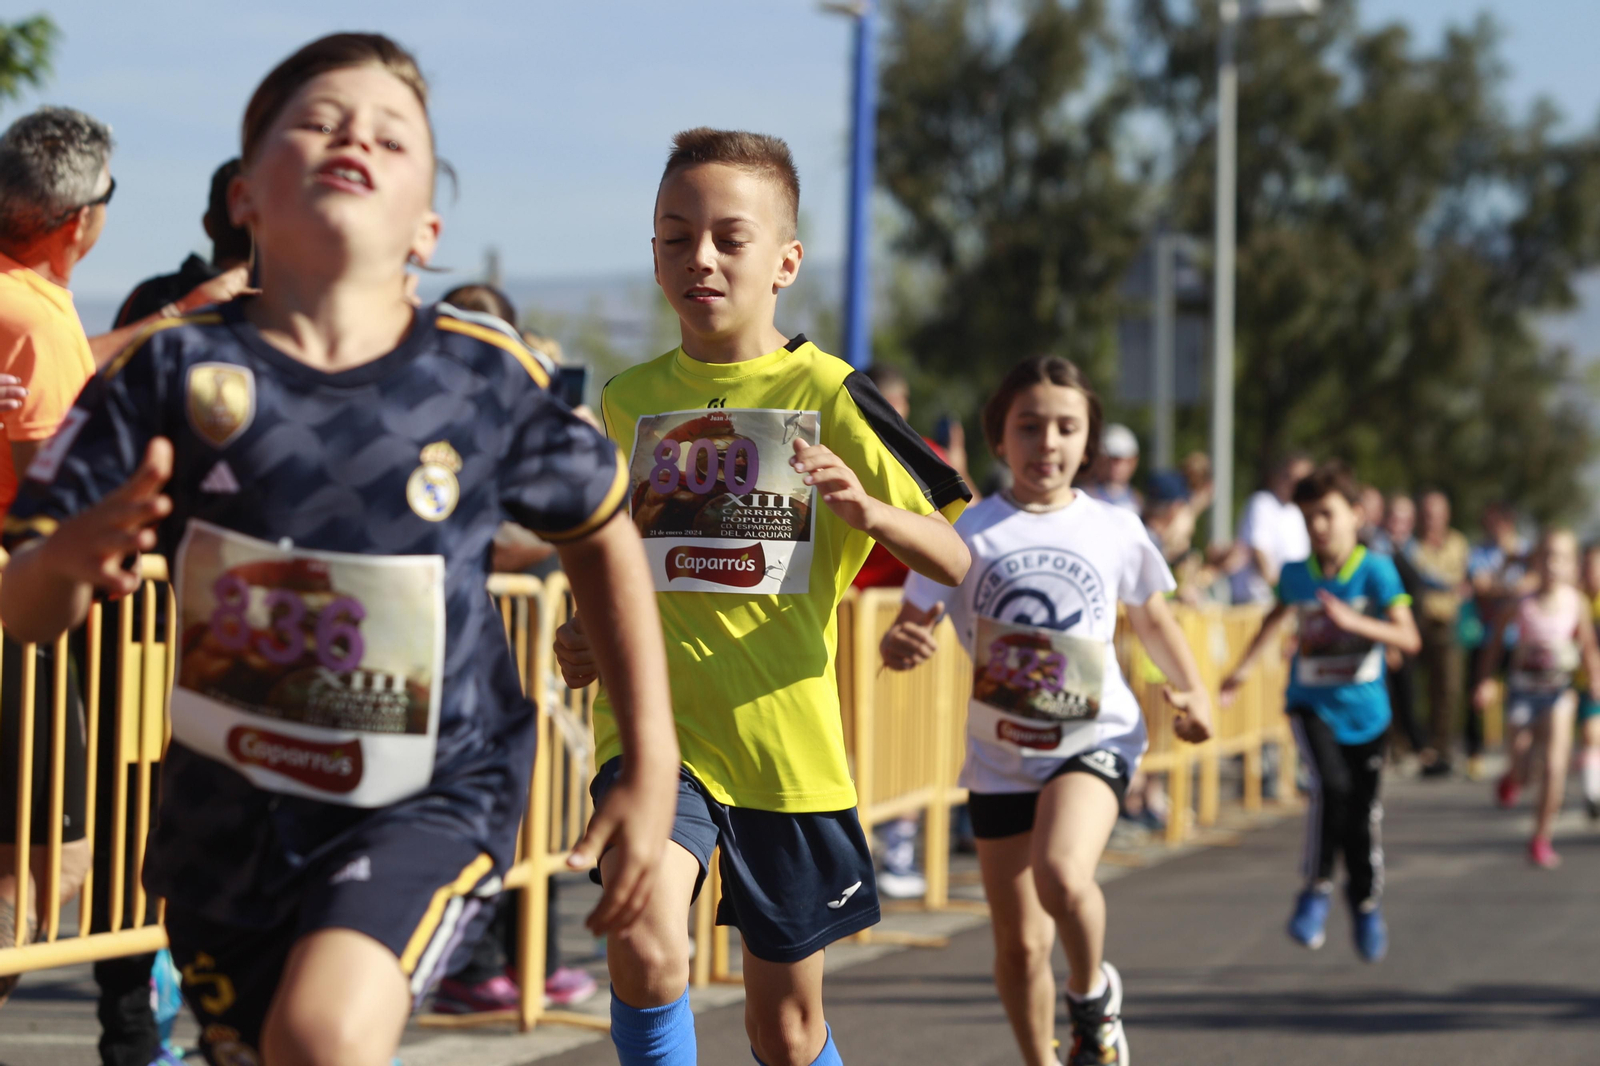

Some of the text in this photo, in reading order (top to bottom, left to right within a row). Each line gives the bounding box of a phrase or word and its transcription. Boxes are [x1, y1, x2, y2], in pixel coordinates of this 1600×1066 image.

[650, 438, 759, 495] 800
[723, 493, 792, 509] XIII
[722, 517, 791, 525] POPULAR
[744, 531, 791, 539] ALQUIÁN
[210, 571, 367, 673] 836
[989, 641, 1068, 692] 823
